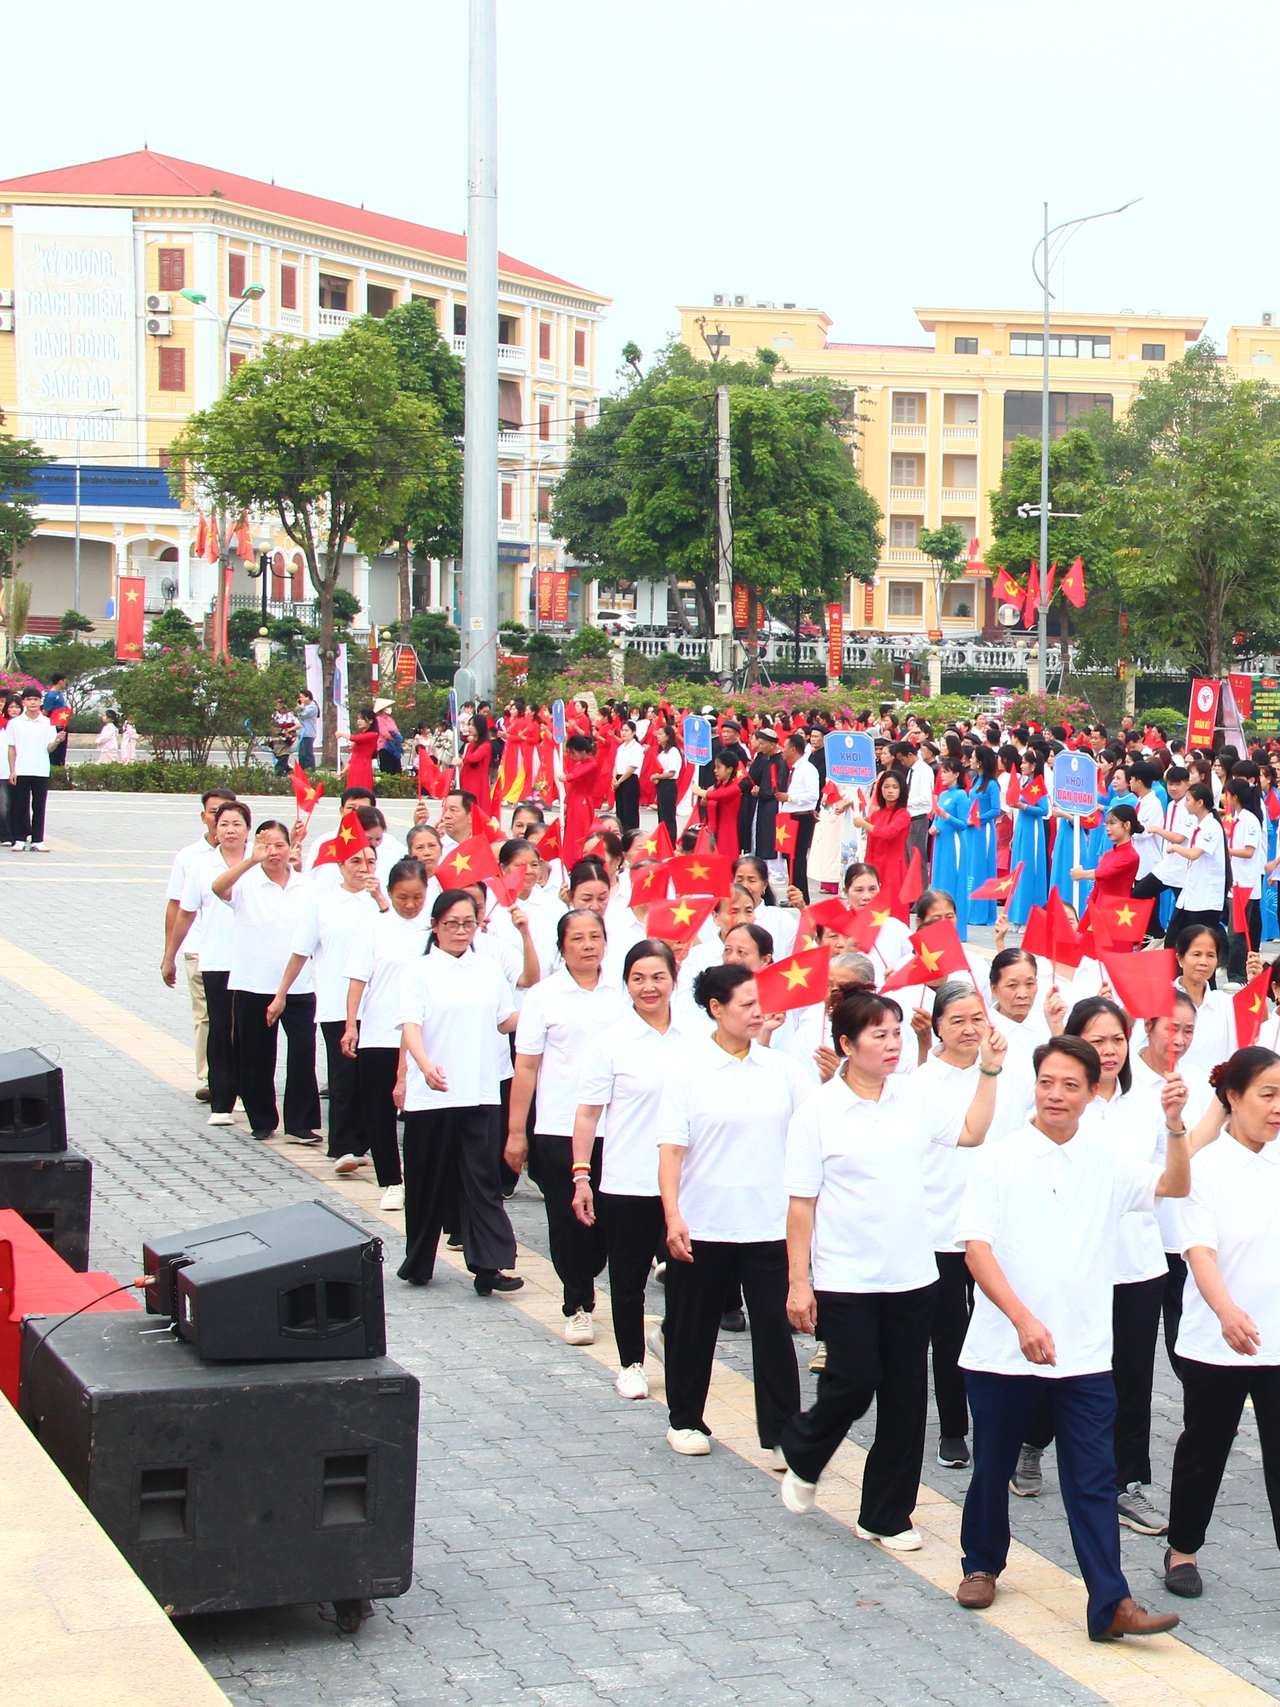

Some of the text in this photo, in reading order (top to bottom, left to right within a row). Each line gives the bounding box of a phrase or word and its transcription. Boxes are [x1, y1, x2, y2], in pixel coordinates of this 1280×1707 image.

[26, 287, 127, 322] TRÁCH NHIỆM,
[32, 328, 120, 363] HÀNH ĐỘNG,
[40, 369, 114, 404] SÁNG TẠO,
[840, 750, 861, 762] KHỐI
[832, 765, 872, 777] HỌC SINH THCS
[1066, 772, 1084, 787] KHỐI
[1057, 787, 1093, 805] DÂN QUÂN
